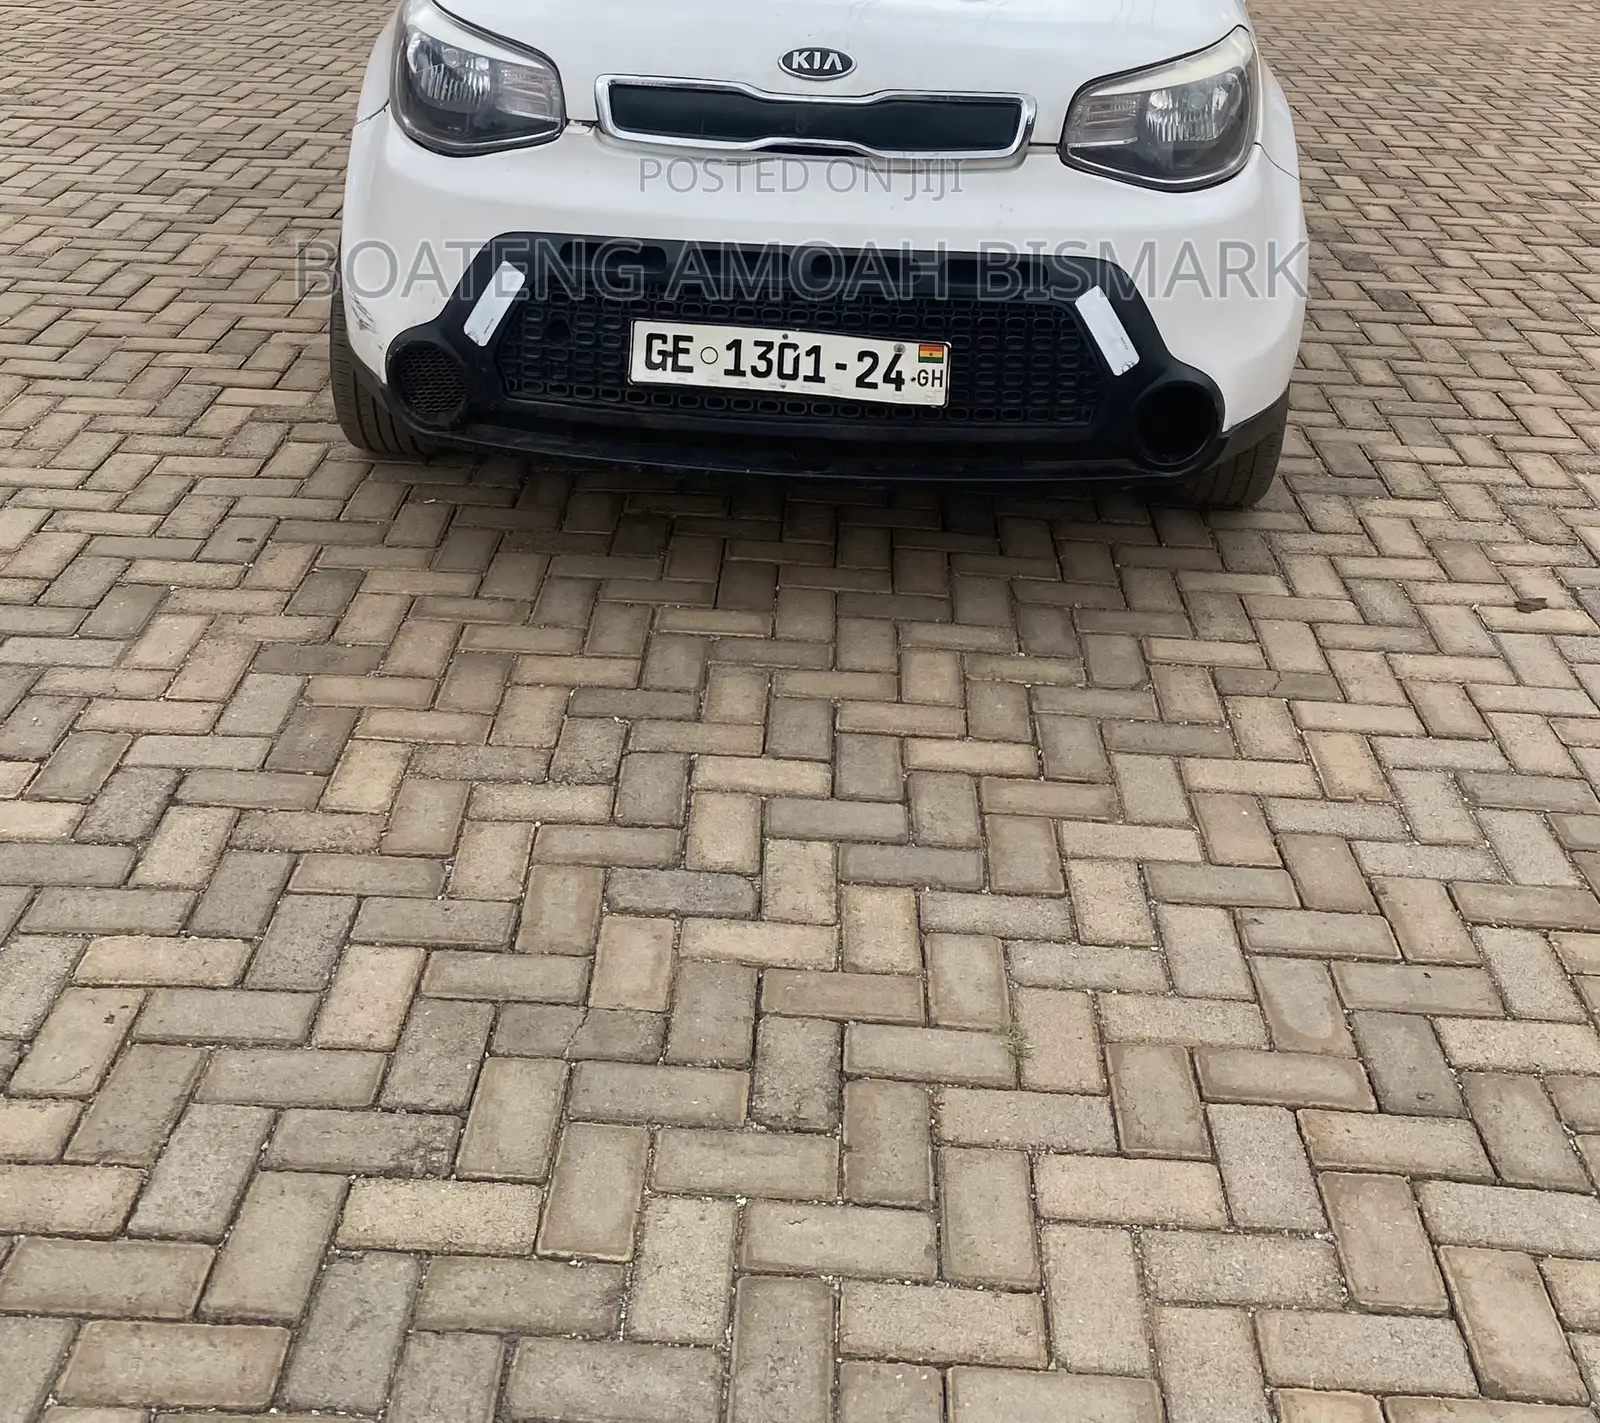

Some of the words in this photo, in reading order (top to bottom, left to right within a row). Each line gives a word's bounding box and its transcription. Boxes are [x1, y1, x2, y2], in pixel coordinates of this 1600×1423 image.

[791, 51, 843, 71] KIA
[645, 332, 694, 373] GE
[723, 339, 906, 392] 1301-24
[917, 368, 944, 388] GH
